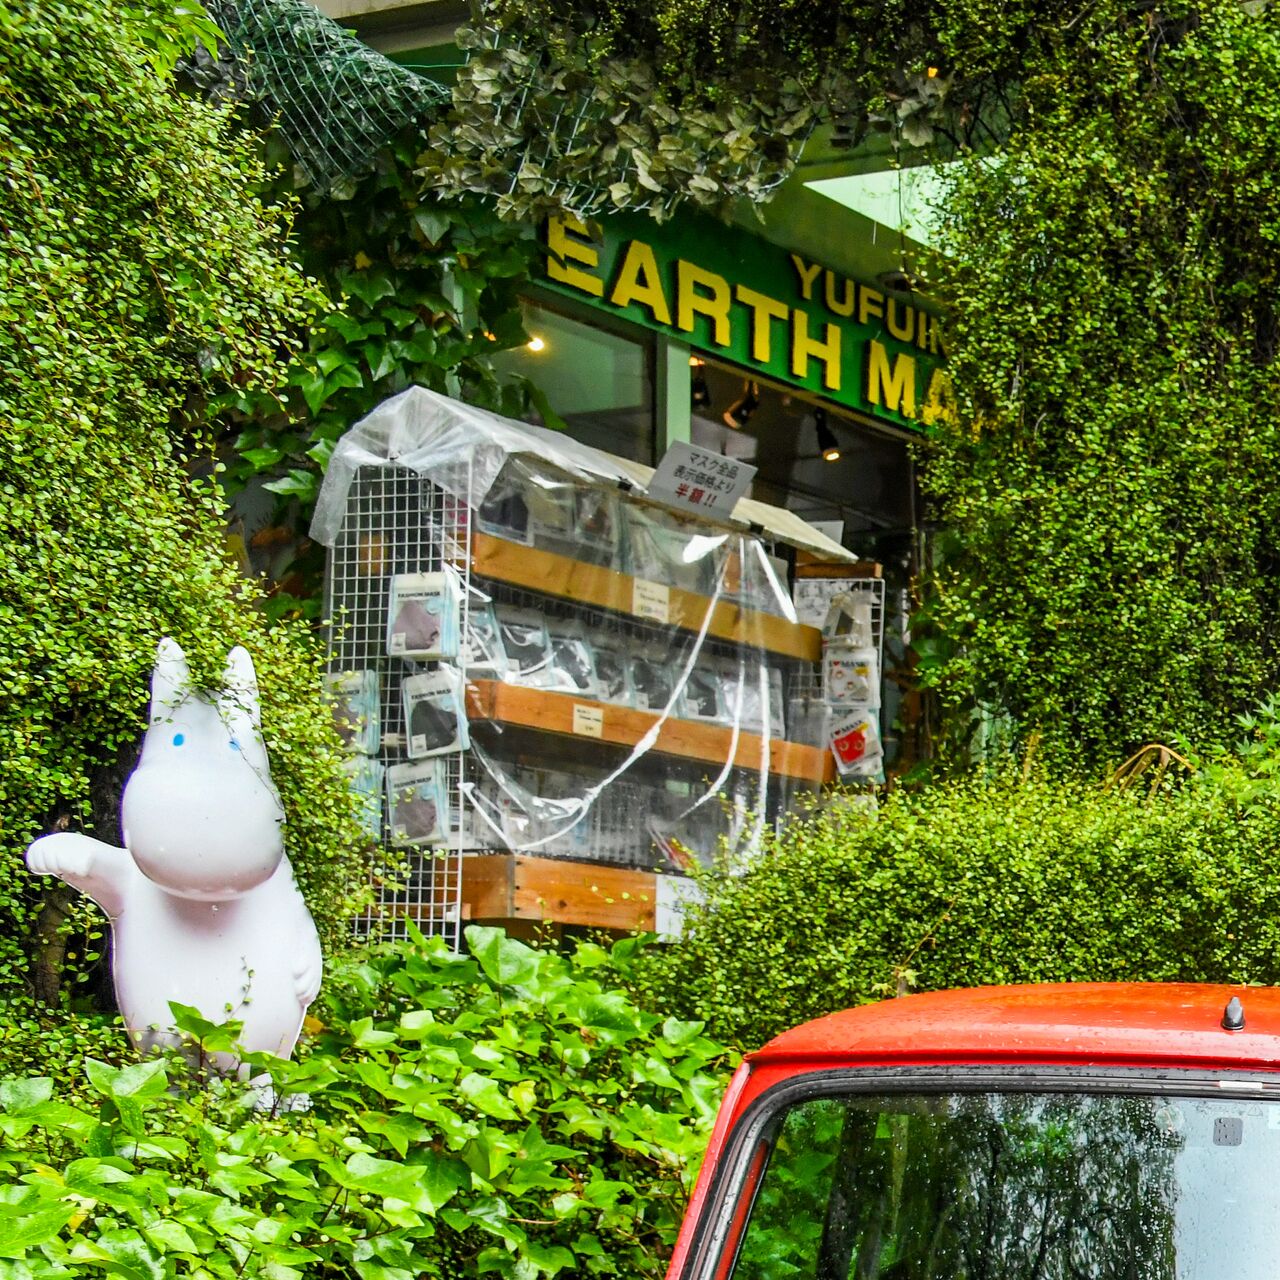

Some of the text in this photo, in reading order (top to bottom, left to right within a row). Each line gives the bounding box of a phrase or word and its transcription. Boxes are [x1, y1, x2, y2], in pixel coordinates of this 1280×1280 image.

[547, 211, 968, 432] EARTH MA
[673, 465, 736, 494] 表示価格より
[689, 452, 739, 480] マスク全品
